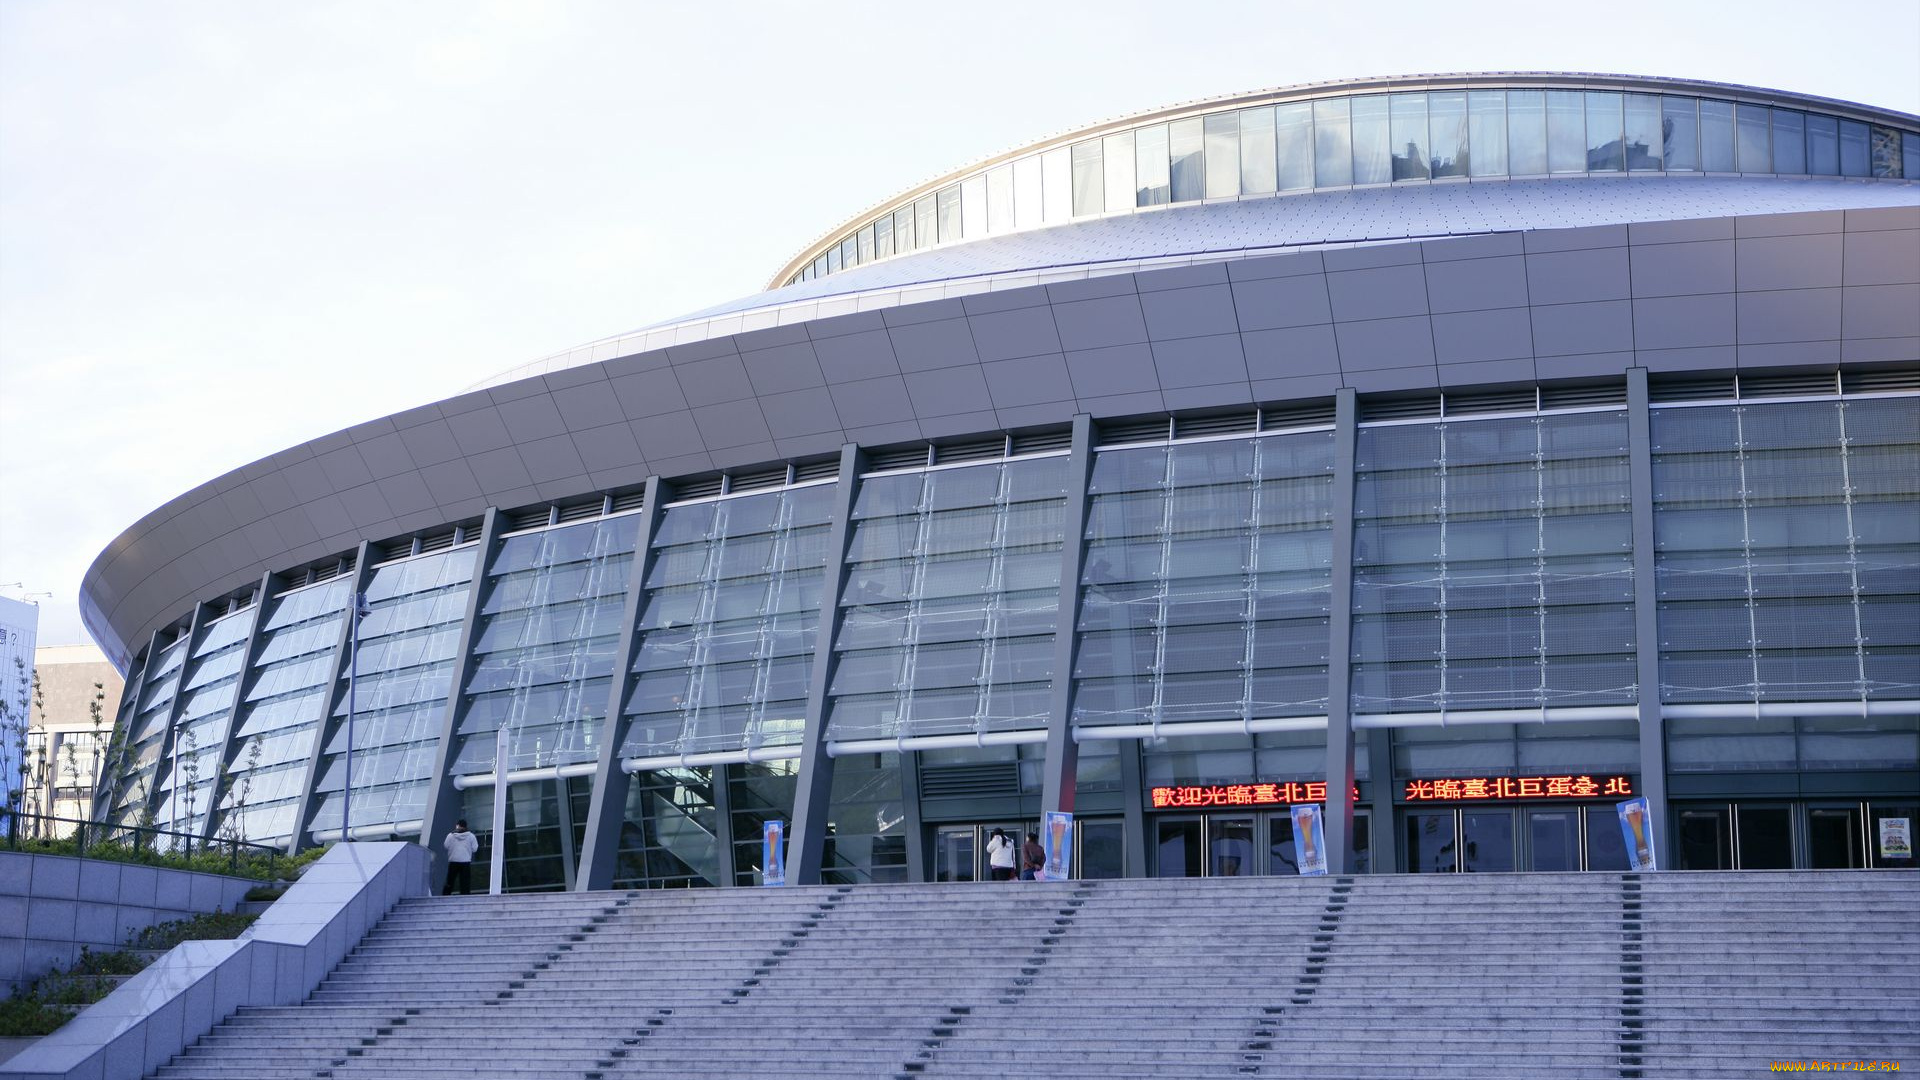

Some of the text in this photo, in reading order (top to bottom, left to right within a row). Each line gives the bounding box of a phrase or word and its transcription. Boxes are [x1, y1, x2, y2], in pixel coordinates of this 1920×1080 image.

[1151, 782, 1359, 808] 歡迎光臨臺北巨
